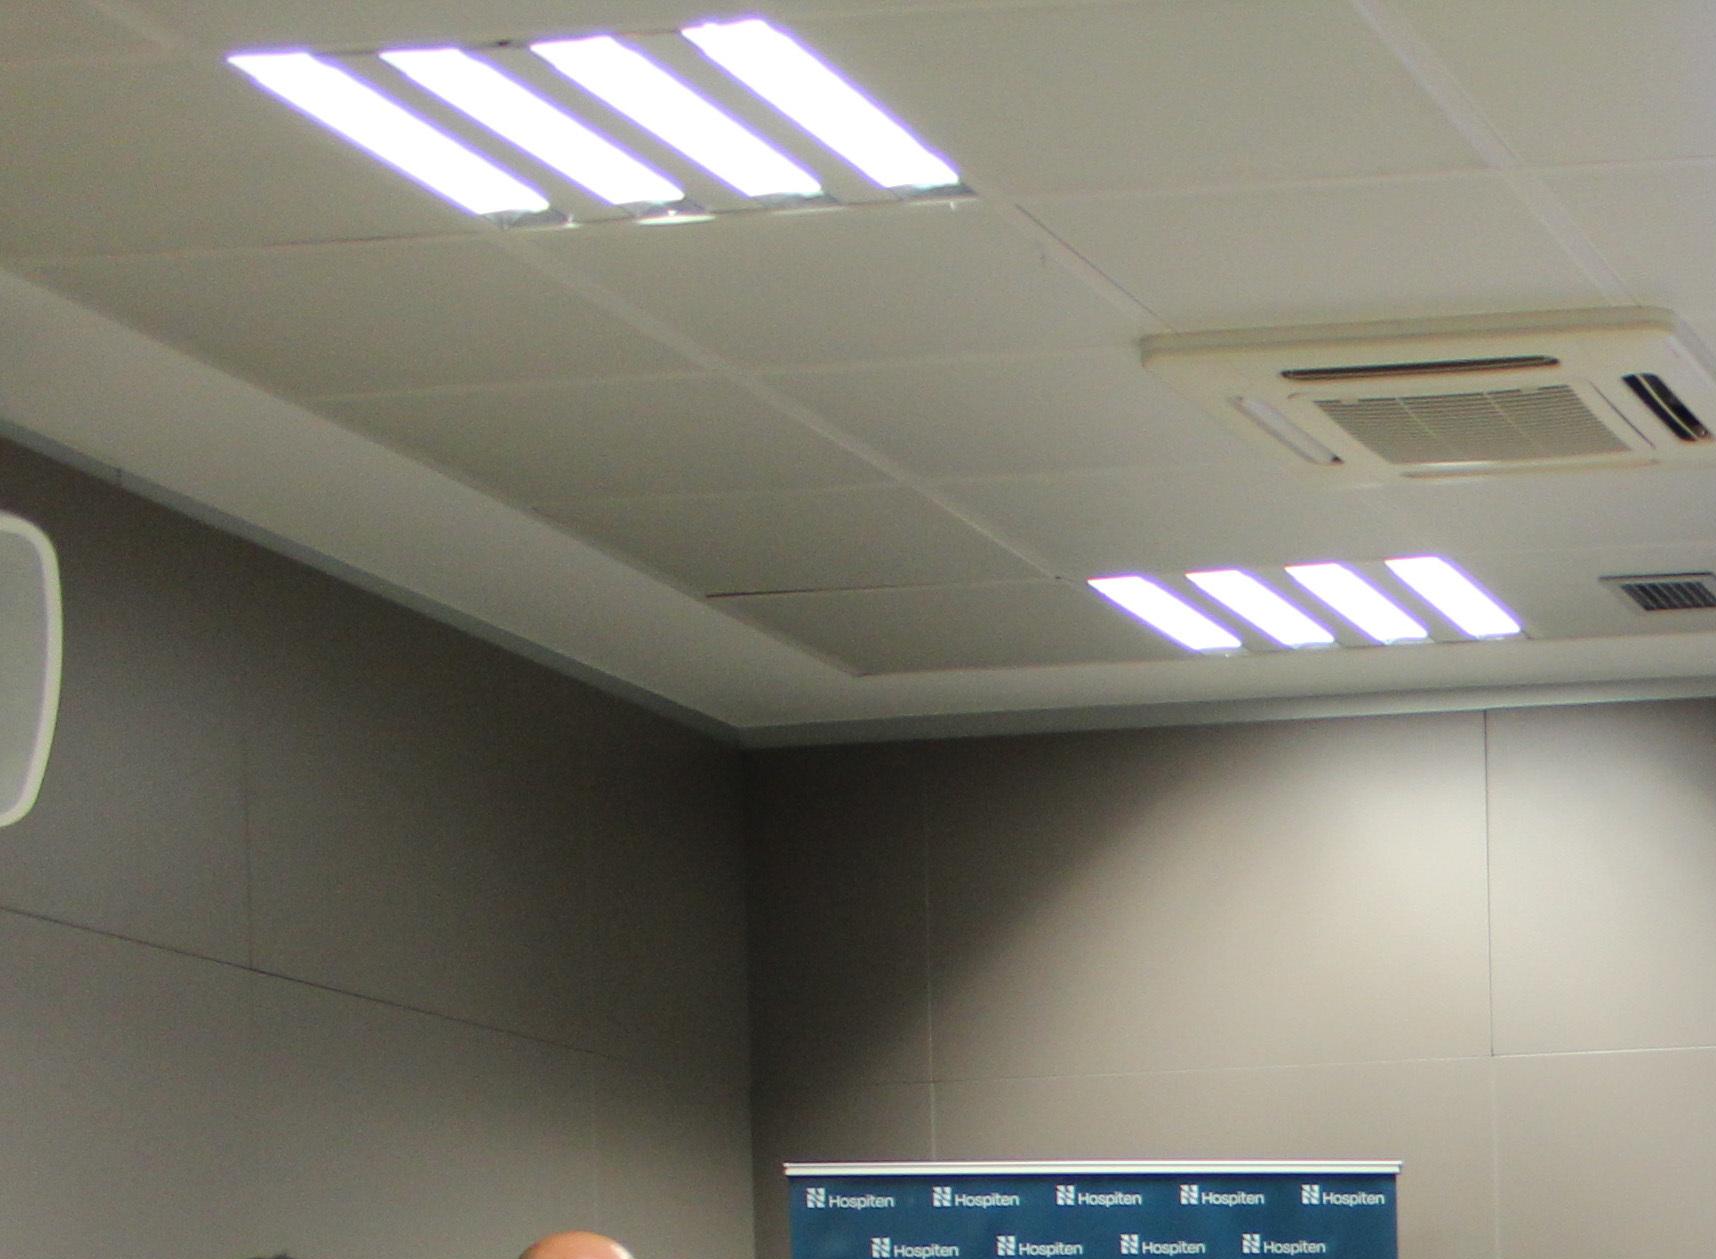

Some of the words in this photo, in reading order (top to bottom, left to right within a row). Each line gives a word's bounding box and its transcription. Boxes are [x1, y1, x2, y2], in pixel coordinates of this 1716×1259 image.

[829, 1194, 894, 1210] Hospiten
[955, 1193, 1020, 1208] Hospiten
[1078, 1192, 1143, 1207] Hospiten
[1201, 1192, 1264, 1206] Hospiten
[1323, 1191, 1385, 1206] Hospiten
[894, 1244, 960, 1259] Hospiten
[1019, 1242, 1083, 1257] Hospiten
[1142, 1241, 1205, 1256] Hospiten
[1263, 1240, 1326, 1255] Hospiten
